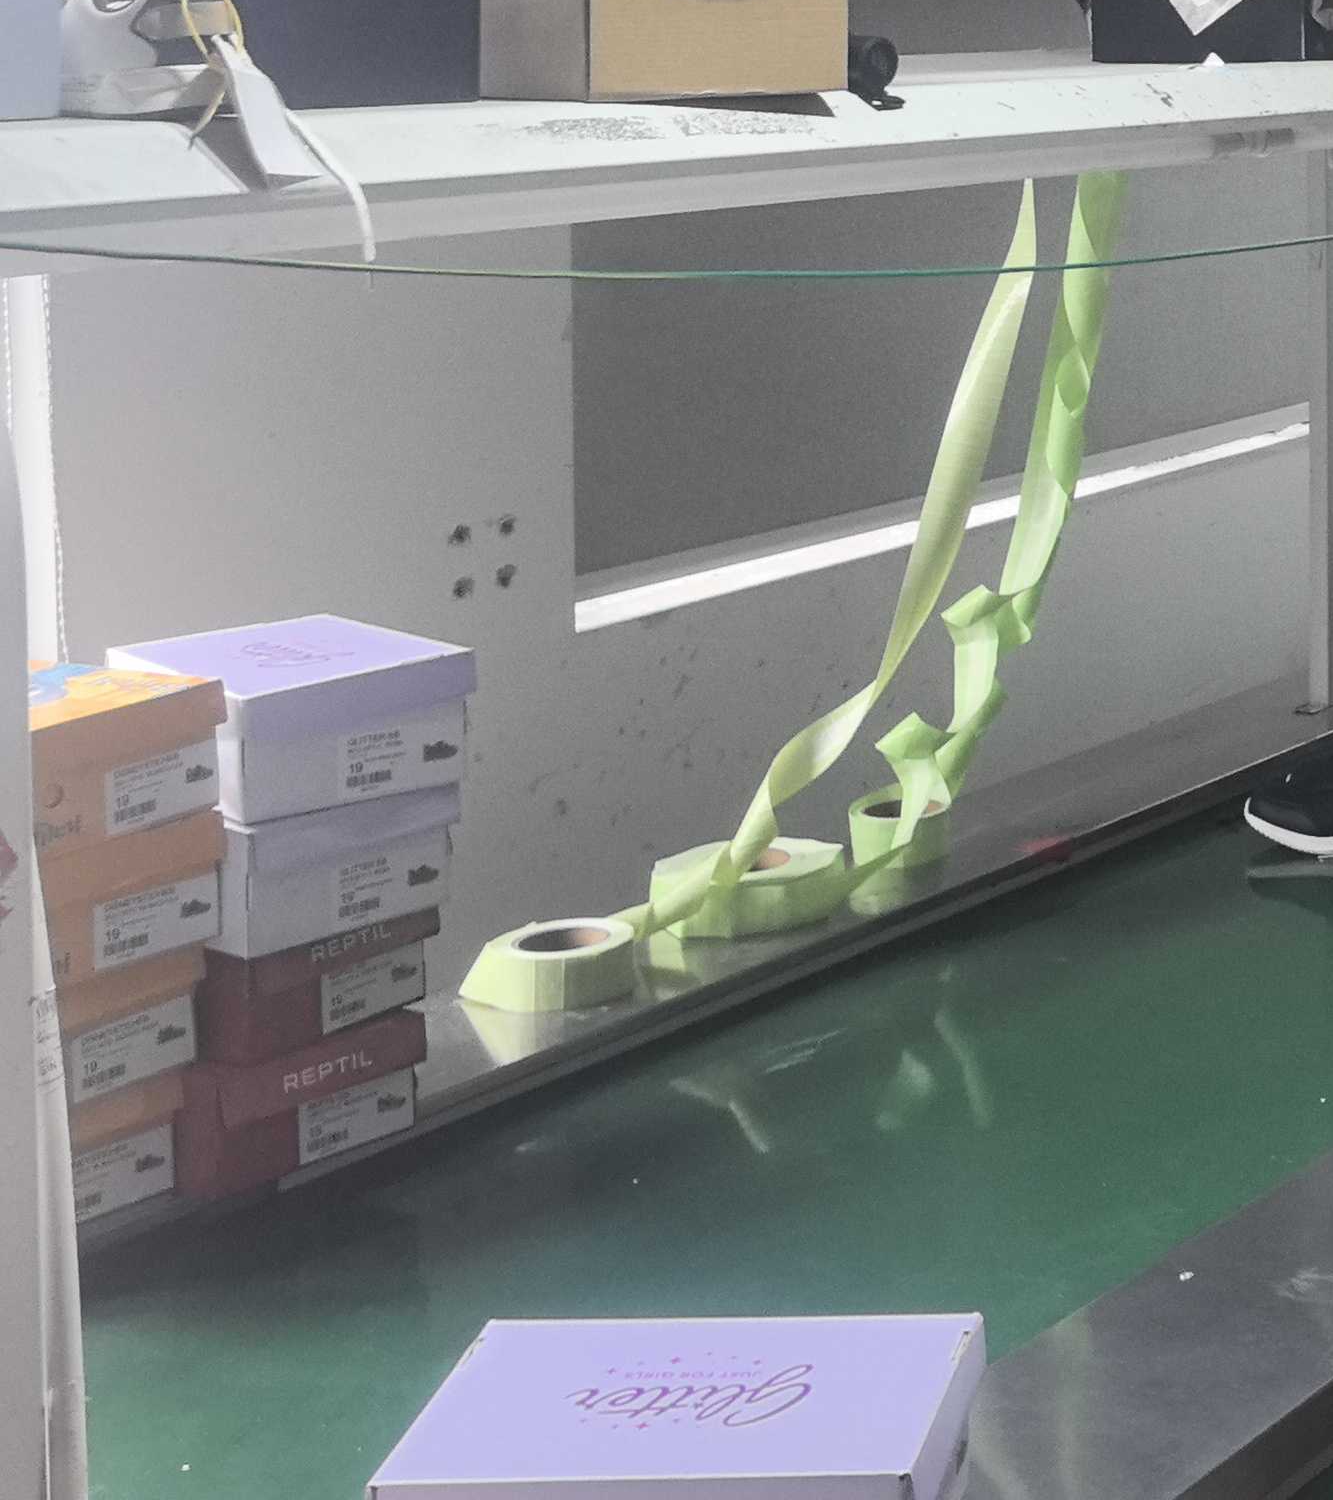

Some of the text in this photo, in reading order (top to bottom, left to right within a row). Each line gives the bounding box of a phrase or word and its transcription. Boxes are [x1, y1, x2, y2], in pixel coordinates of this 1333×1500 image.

[310, 923, 391, 963] REPTIL
[283, 1050, 373, 1094] REPTIL
[624, 1369, 763, 1380] JUST FOR GIRLS
[564, 1363, 813, 1429] Glitter
